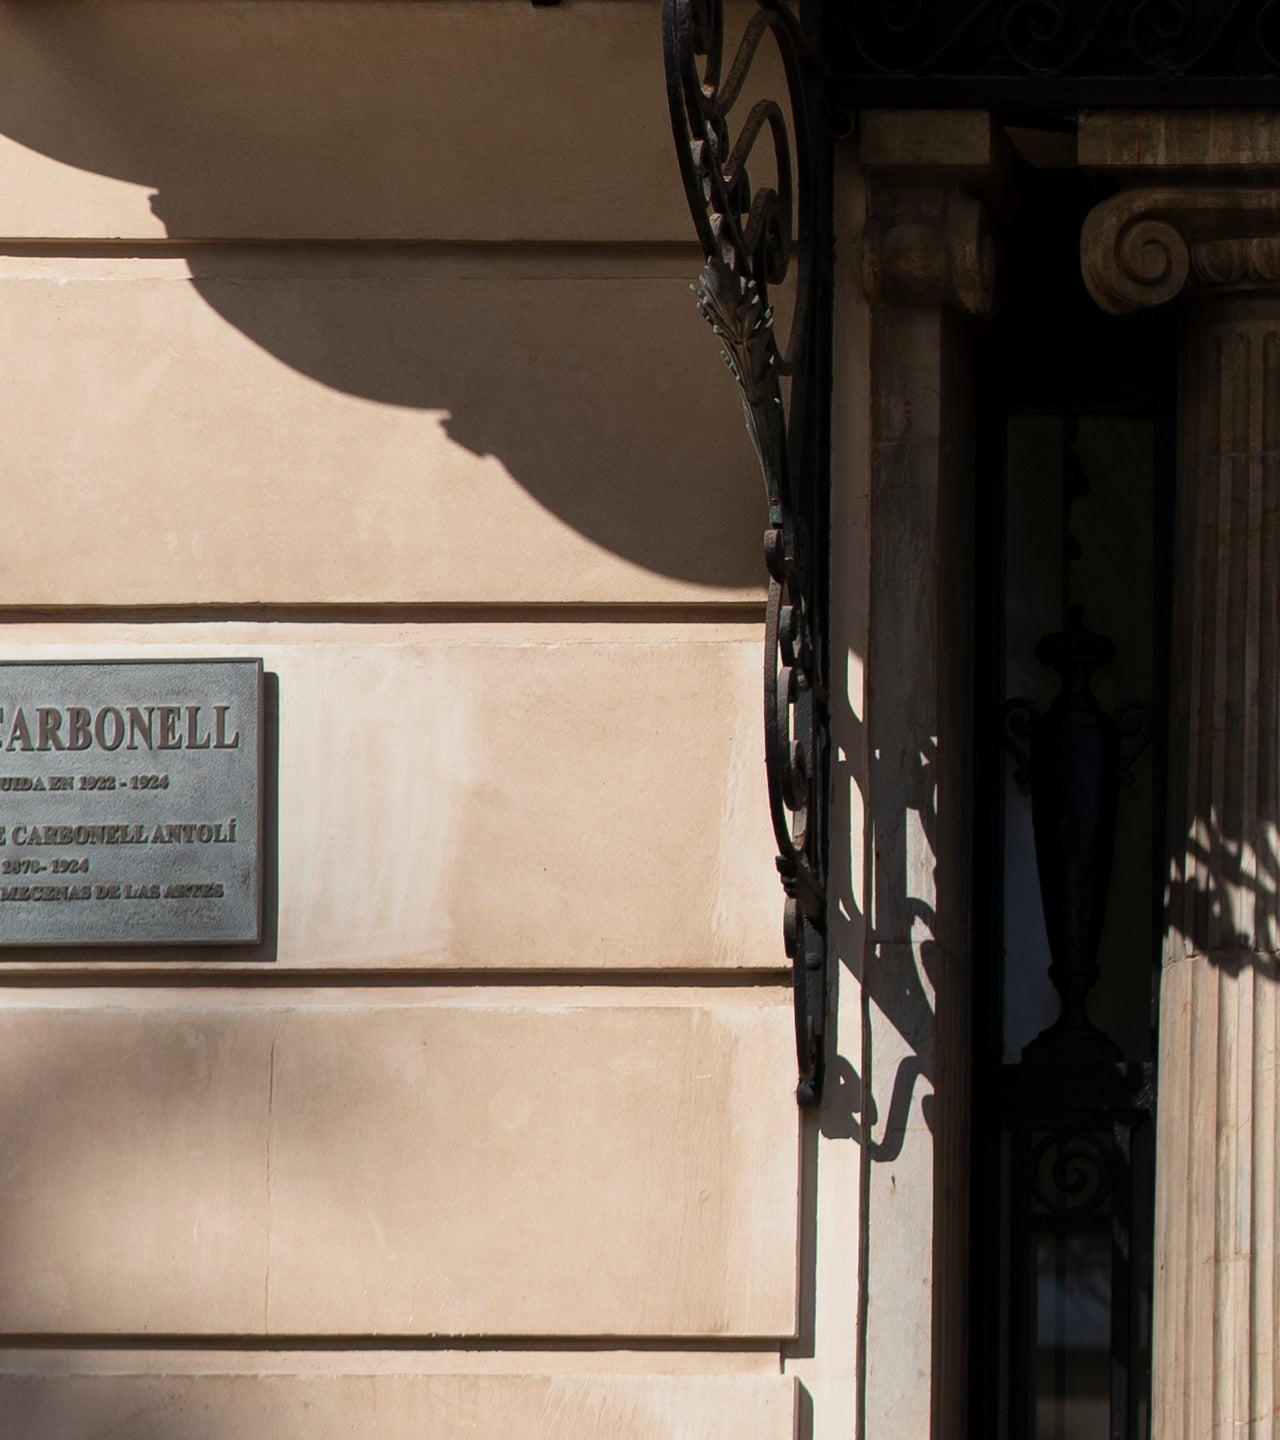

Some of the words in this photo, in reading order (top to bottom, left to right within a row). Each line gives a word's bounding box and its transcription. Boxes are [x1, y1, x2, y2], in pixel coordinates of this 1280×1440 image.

[47, 776, 75, 790] EN
[78, 775, 117, 790] 1922
[130, 773, 169, 790] 1924
[11, 824, 149, 846] CARBONELL
[151, 817, 237, 844] ANTOLÍ
[50, 856, 90, 873] 1924
[0, 883, 92, 901] MECENAS
[95, 883, 121, 900] DE
[124, 883, 160, 899] LAS
[163, 881, 224, 899] ARTES
